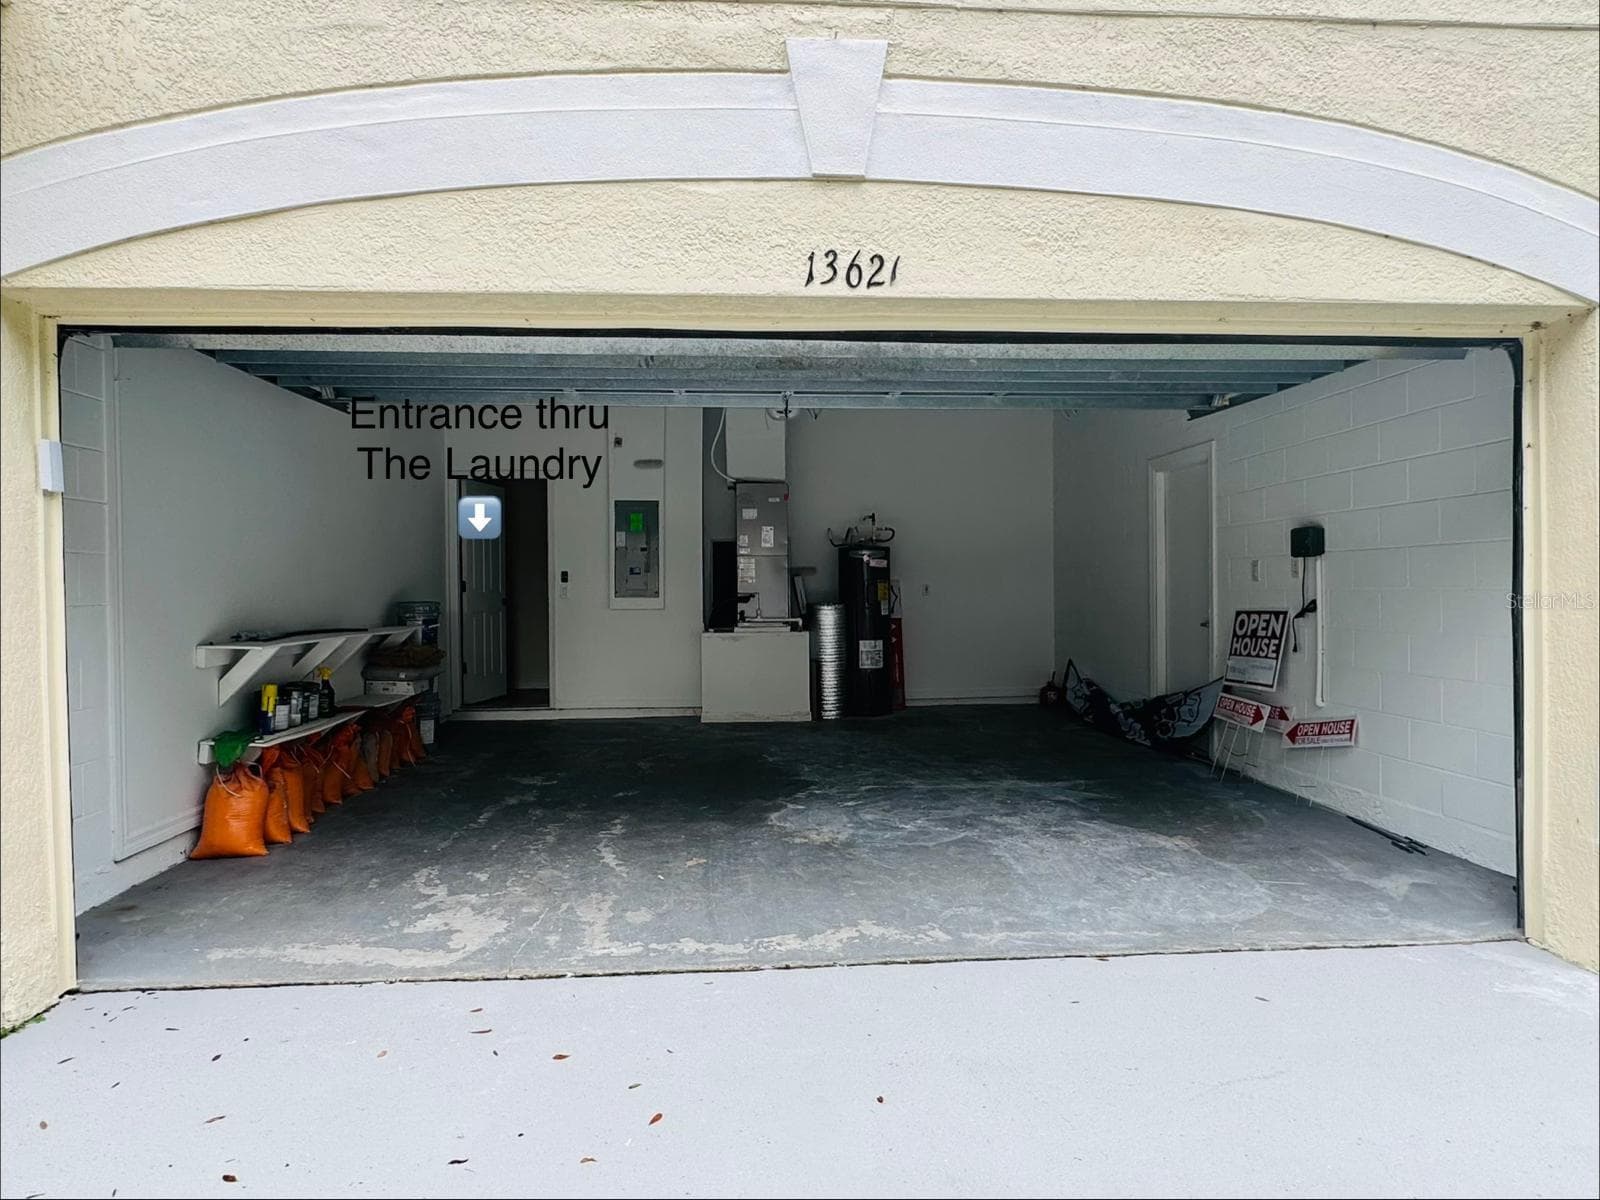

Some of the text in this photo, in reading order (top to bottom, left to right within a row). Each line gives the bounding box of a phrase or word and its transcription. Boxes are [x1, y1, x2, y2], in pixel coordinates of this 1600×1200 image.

[804, 249, 900, 289] 13621
[1236, 613, 1284, 637] OPEN
[1232, 637, 1279, 657] HOUSE
[1219, 697, 1234, 711] OPEN
[1234, 702, 1256, 717] HOUSE
[1296, 720, 1352, 736] OPEN HOUSE
